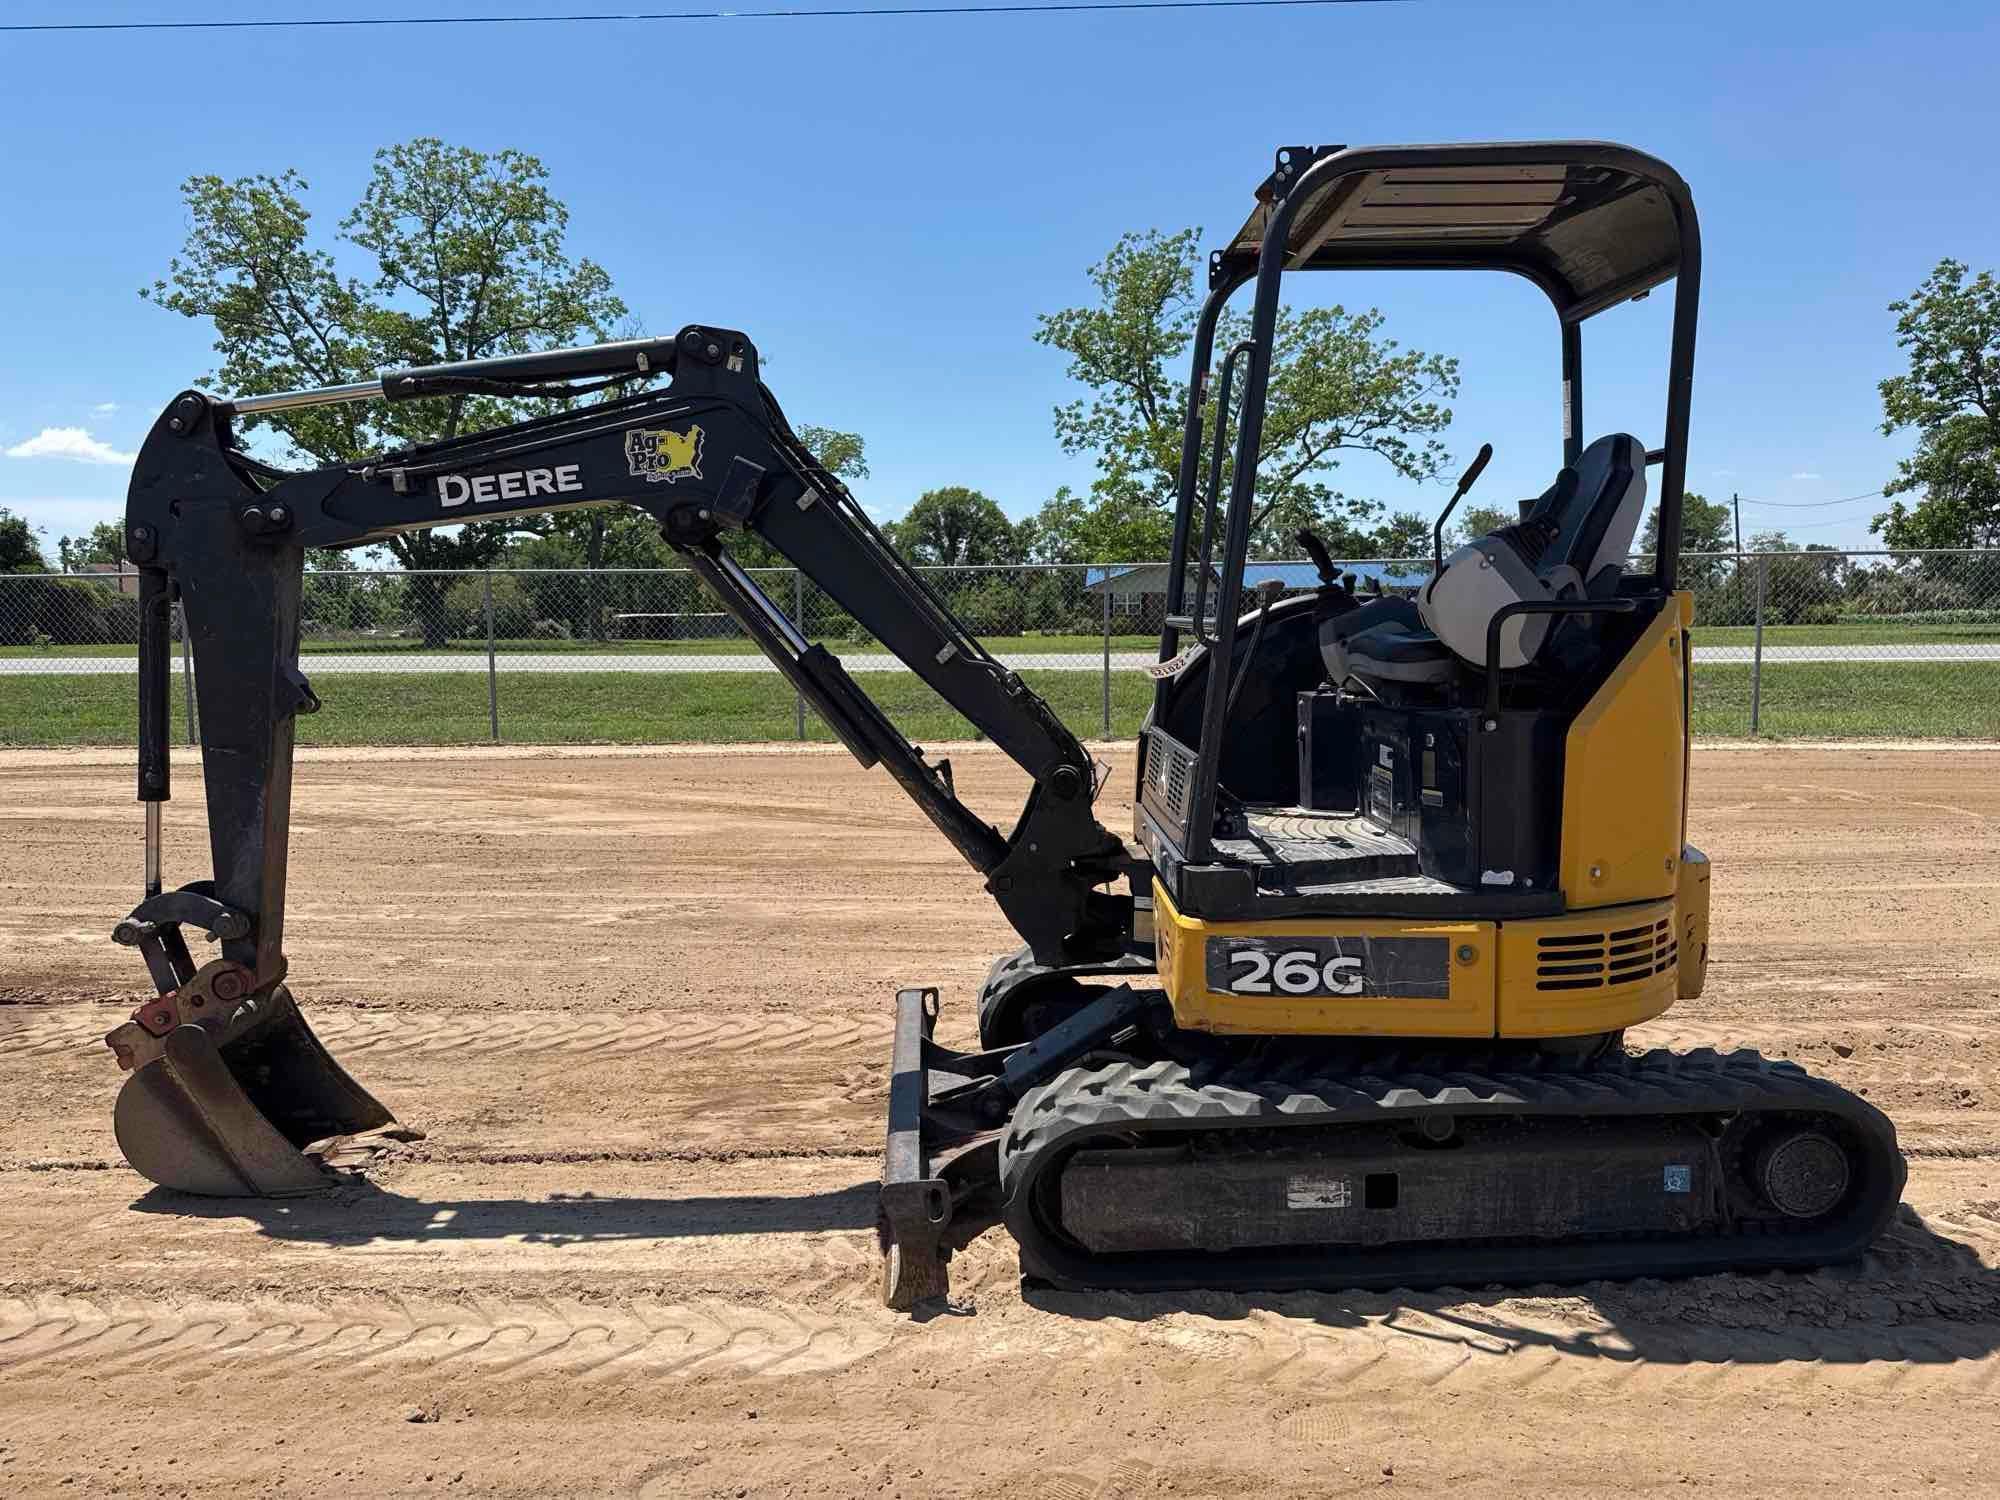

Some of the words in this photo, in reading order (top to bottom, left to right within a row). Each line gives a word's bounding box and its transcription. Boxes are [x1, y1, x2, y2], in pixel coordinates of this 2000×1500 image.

[632, 452, 671, 472] Pro
[437, 464, 583, 507] DEERE
[1231, 951, 1363, 994] 26G
